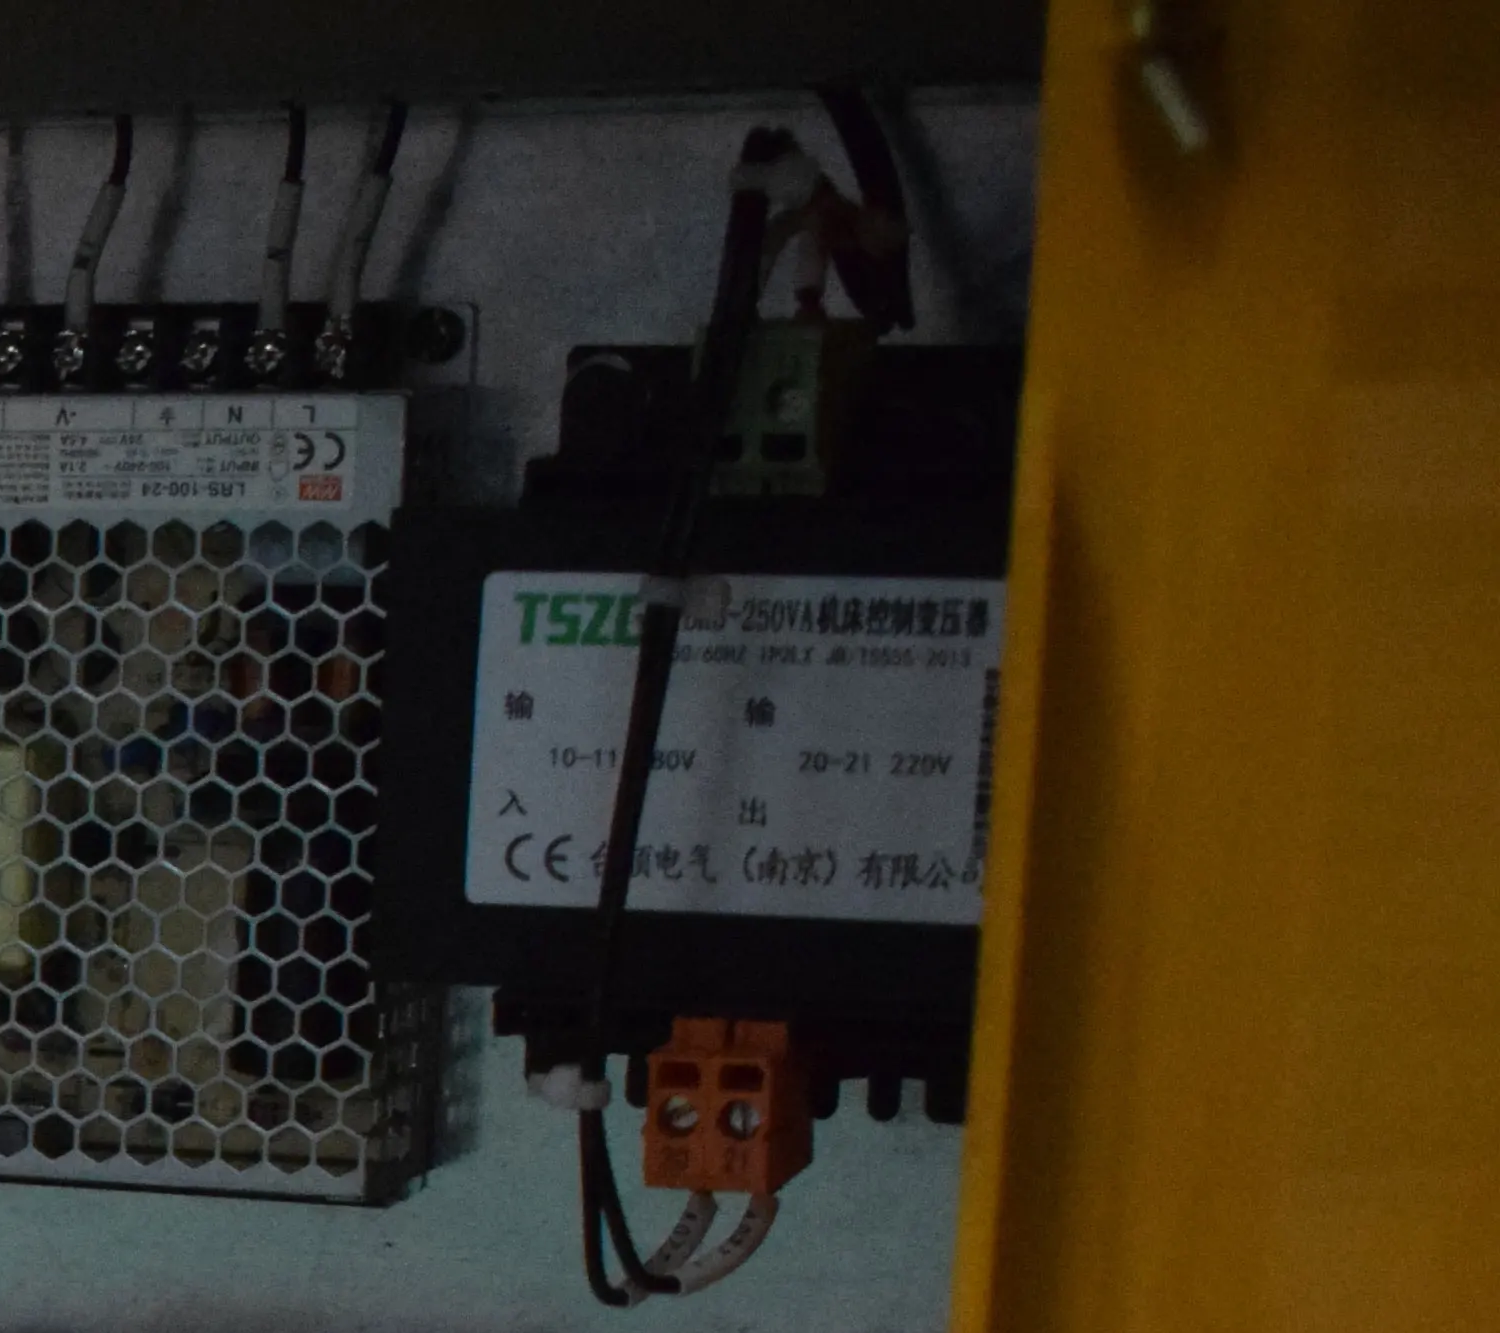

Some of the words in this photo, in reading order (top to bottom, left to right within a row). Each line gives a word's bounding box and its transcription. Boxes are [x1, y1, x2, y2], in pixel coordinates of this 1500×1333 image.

[229, 406, 244, 422] N
[141, 482, 246, 497] LRS-100-24
[799, 752, 872, 773] 20-21
[890, 755, 952, 776] 220V
[739, 797, 768, 827] 出
